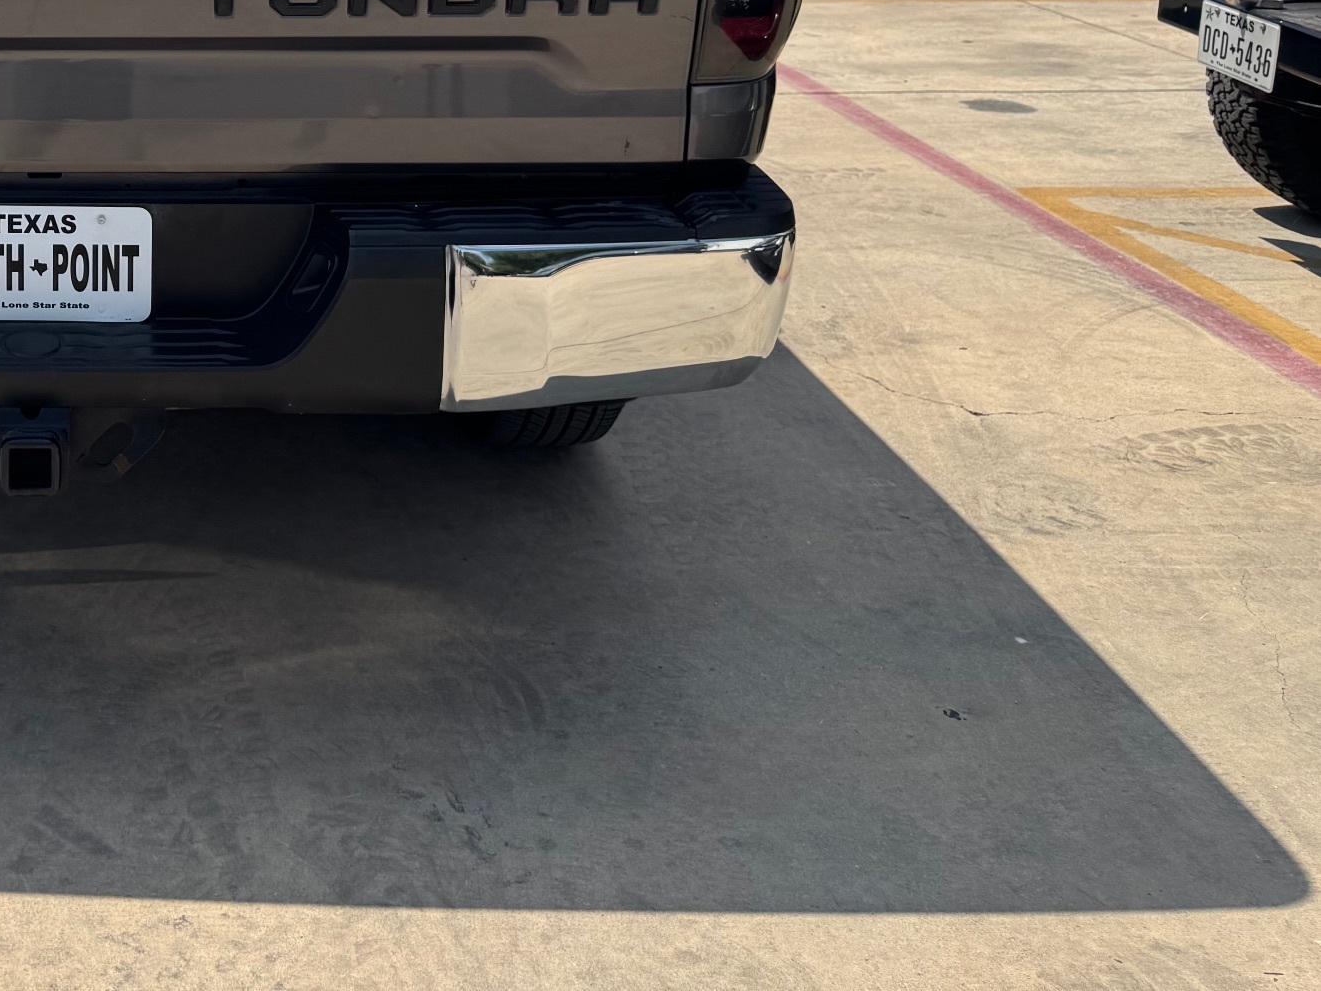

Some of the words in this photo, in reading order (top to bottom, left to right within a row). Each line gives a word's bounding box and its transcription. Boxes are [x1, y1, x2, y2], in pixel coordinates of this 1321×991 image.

[1224, 12, 1255, 33] TEXAS
[1235, 37, 1272, 78] 5436
[52, 243, 140, 293] POINT
[1, 301, 29, 309] Lone
[32, 301, 57, 310] Star
[59, 301, 90, 310] State
